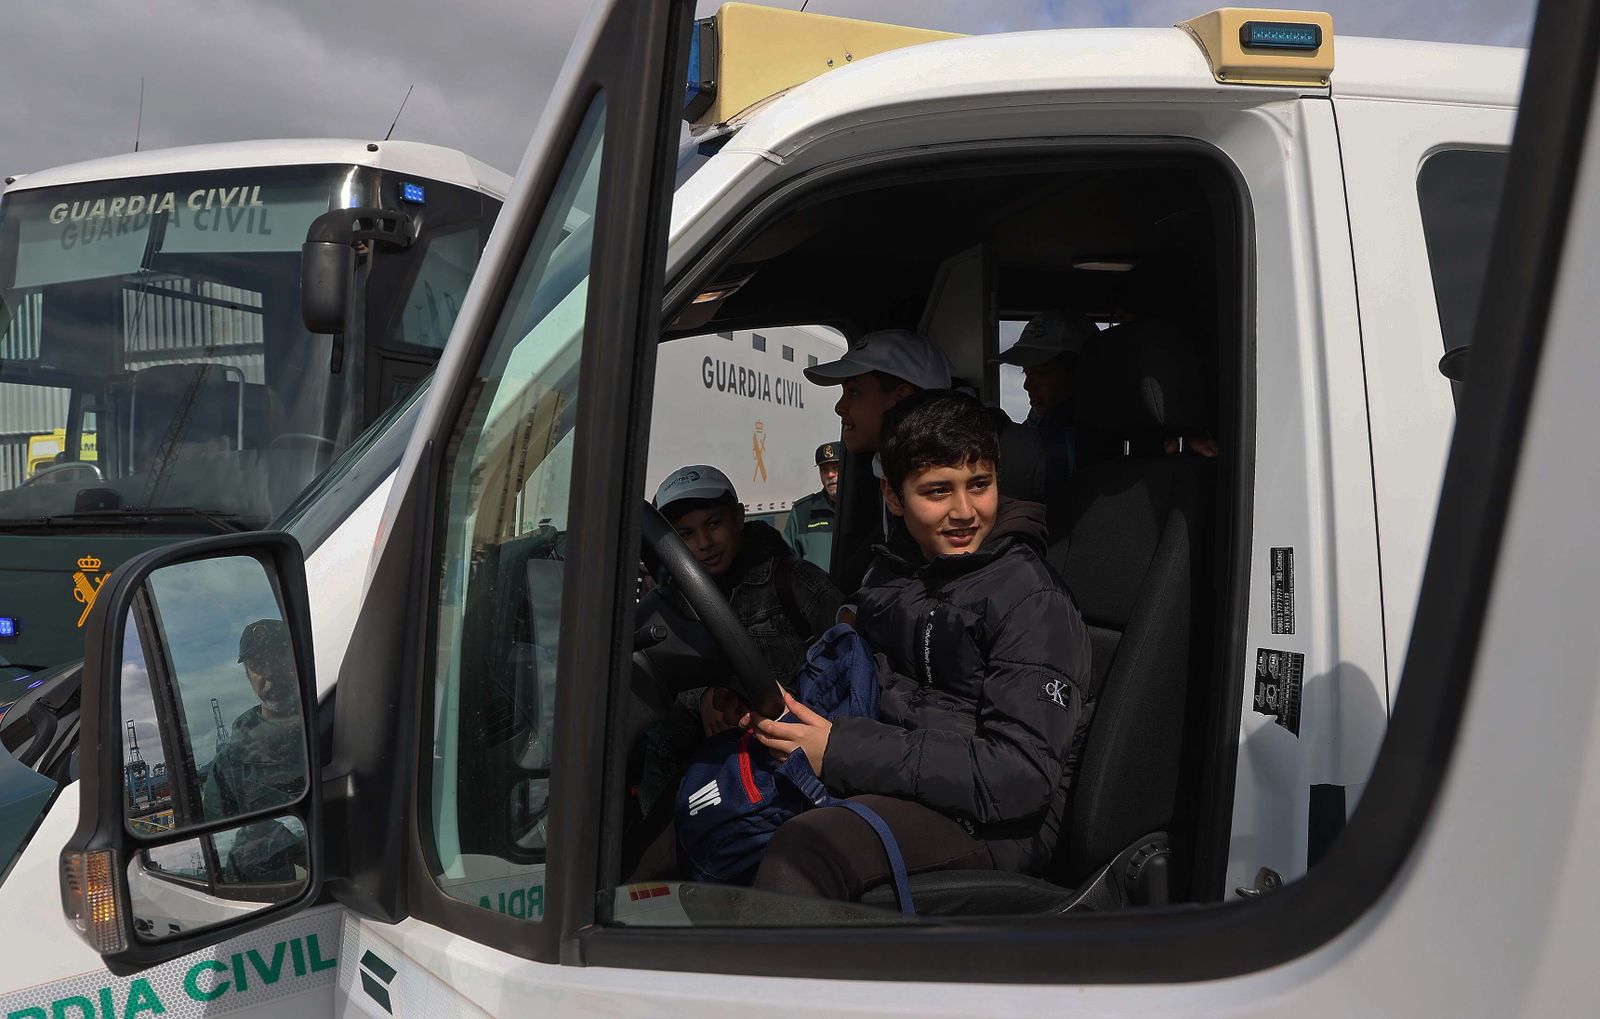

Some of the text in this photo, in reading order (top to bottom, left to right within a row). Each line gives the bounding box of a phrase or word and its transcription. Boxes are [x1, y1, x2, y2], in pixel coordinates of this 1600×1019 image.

[48, 185, 264, 225] GUARDIA CIVIL
[702, 355, 804, 409] GUARDIA CIVIL
[924, 623, 934, 646] Calvin
[183, 933, 338, 1002] CIVIL
